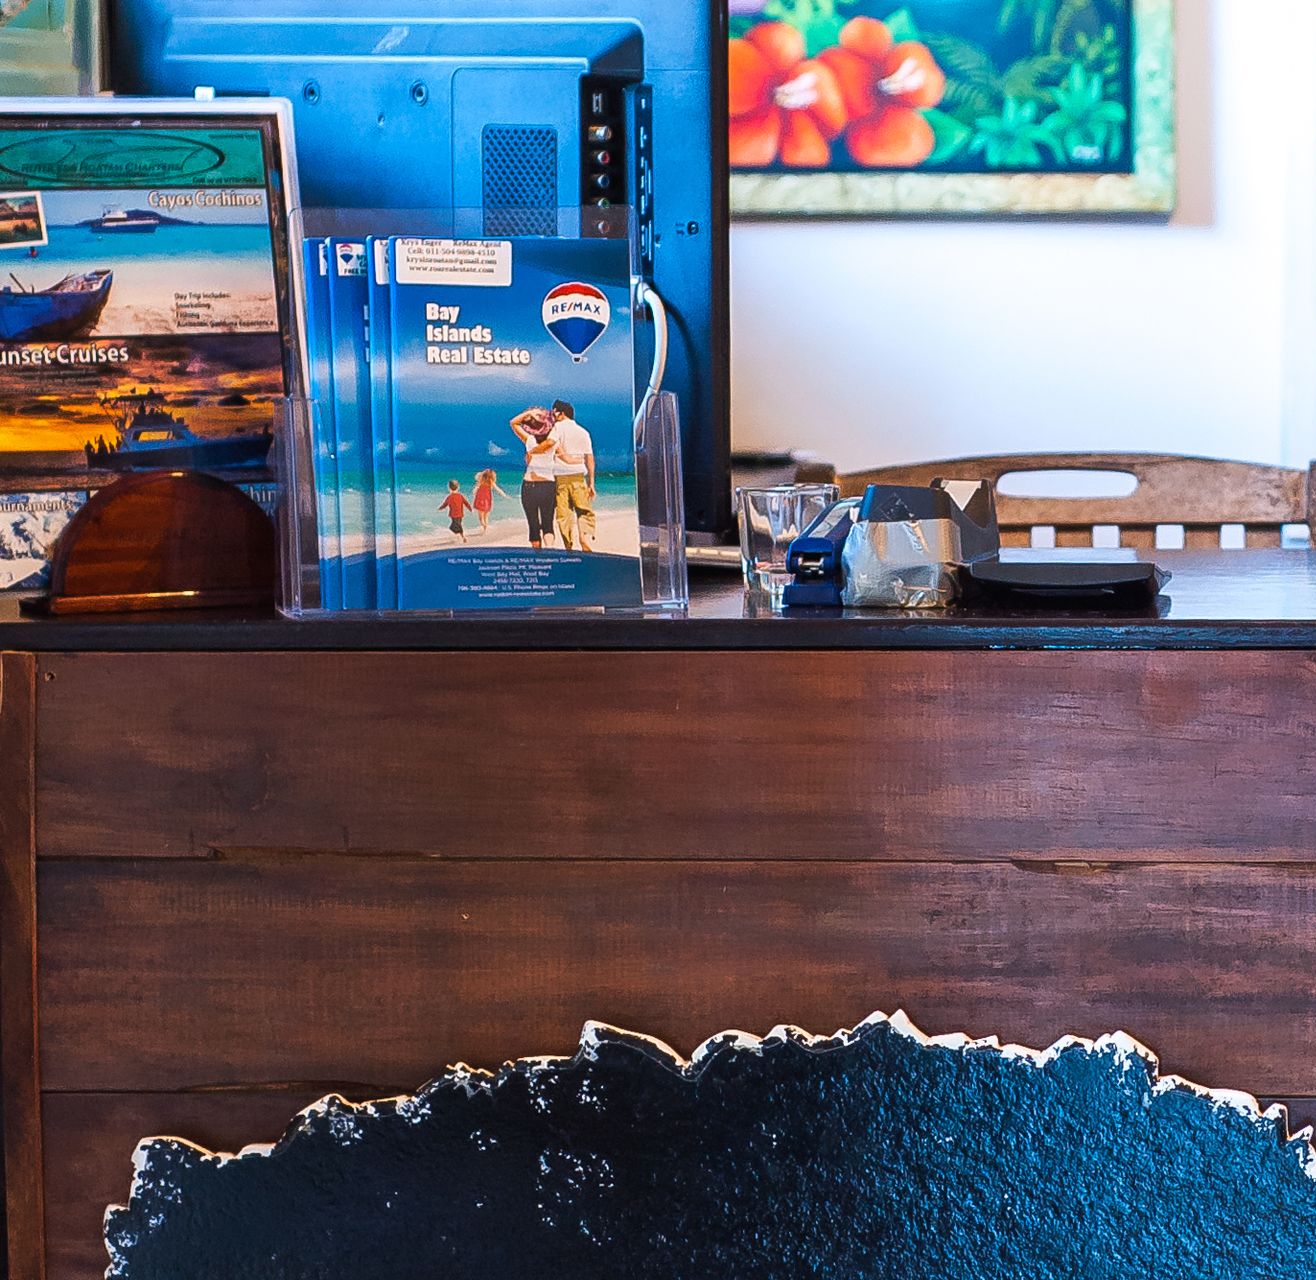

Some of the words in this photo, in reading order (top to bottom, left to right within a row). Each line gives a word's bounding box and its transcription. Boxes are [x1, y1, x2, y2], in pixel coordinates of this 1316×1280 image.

[148, 191, 193, 210] Cayos
[195, 190, 262, 207] Cochinos
[426, 303, 460, 323] Bay
[551, 302, 601, 315] RE/MAX
[426, 325, 492, 343] Islands
[0, 347, 52, 365] unset
[56, 342, 129, 364] Cruises
[427, 347, 467, 364] Real
[474, 347, 530, 365] Estate
[0, 501, 72, 513] urnaments
